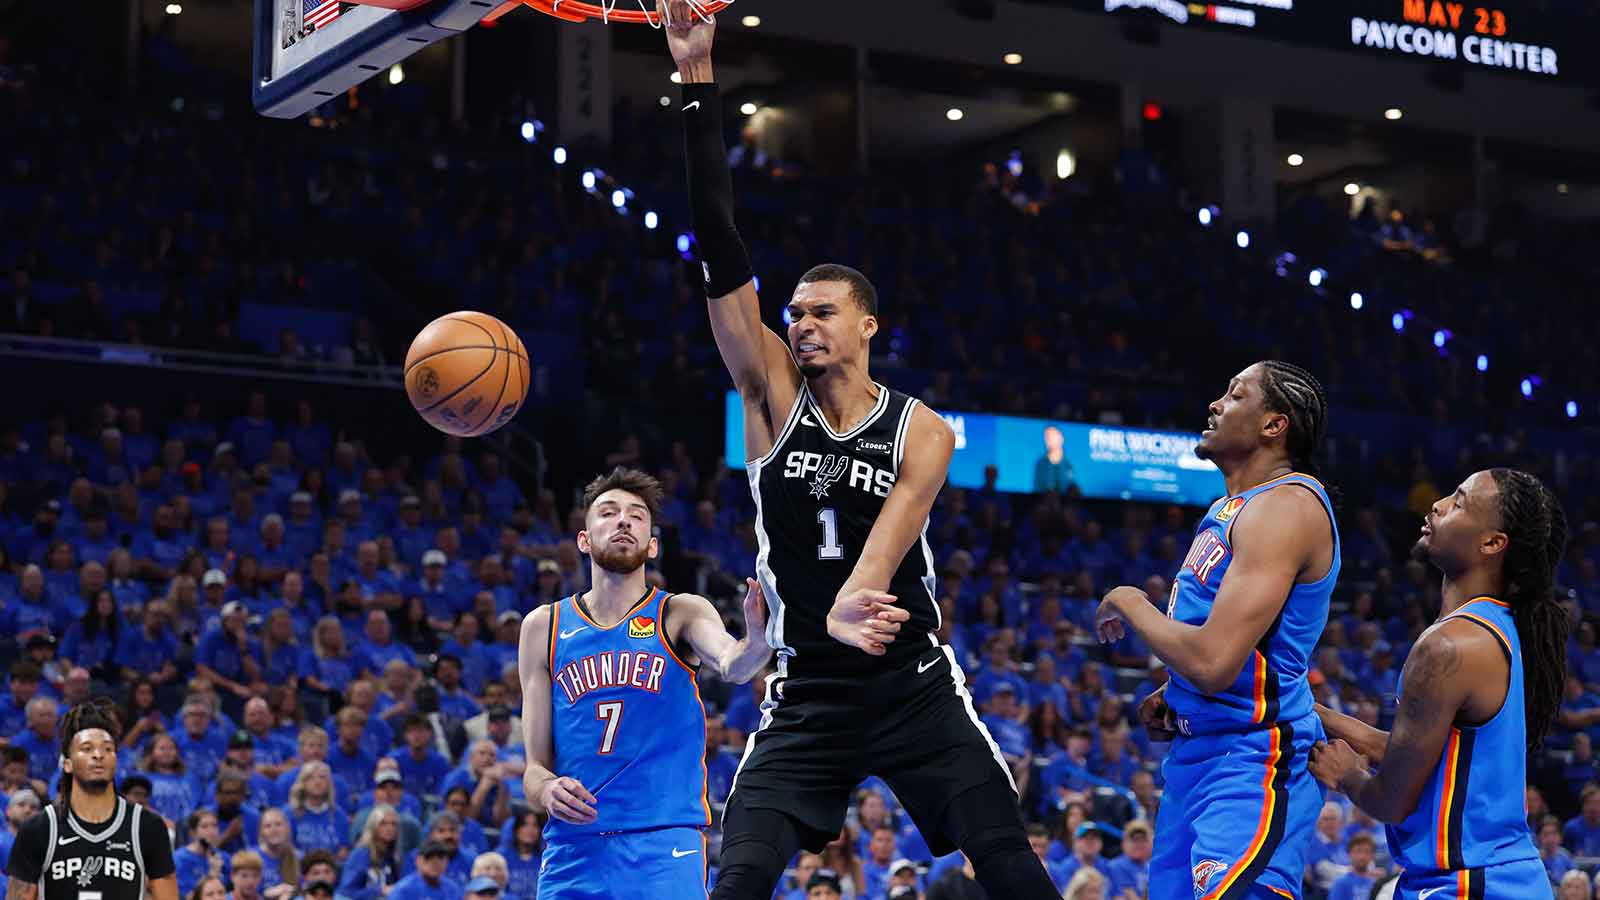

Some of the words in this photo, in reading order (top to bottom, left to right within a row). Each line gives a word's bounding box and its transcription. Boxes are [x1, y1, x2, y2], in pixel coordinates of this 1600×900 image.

[1403, 0, 1463, 29] MAY
[1474, 7, 1507, 36] 23
[1351, 17, 1457, 60] PAYCOM
[1462, 35, 1558, 75] CENTER
[860, 441, 888, 451] LEDGER
[817, 506, 844, 560] 1
[556, 652, 665, 704] THUNDER
[597, 701, 624, 754] 7
